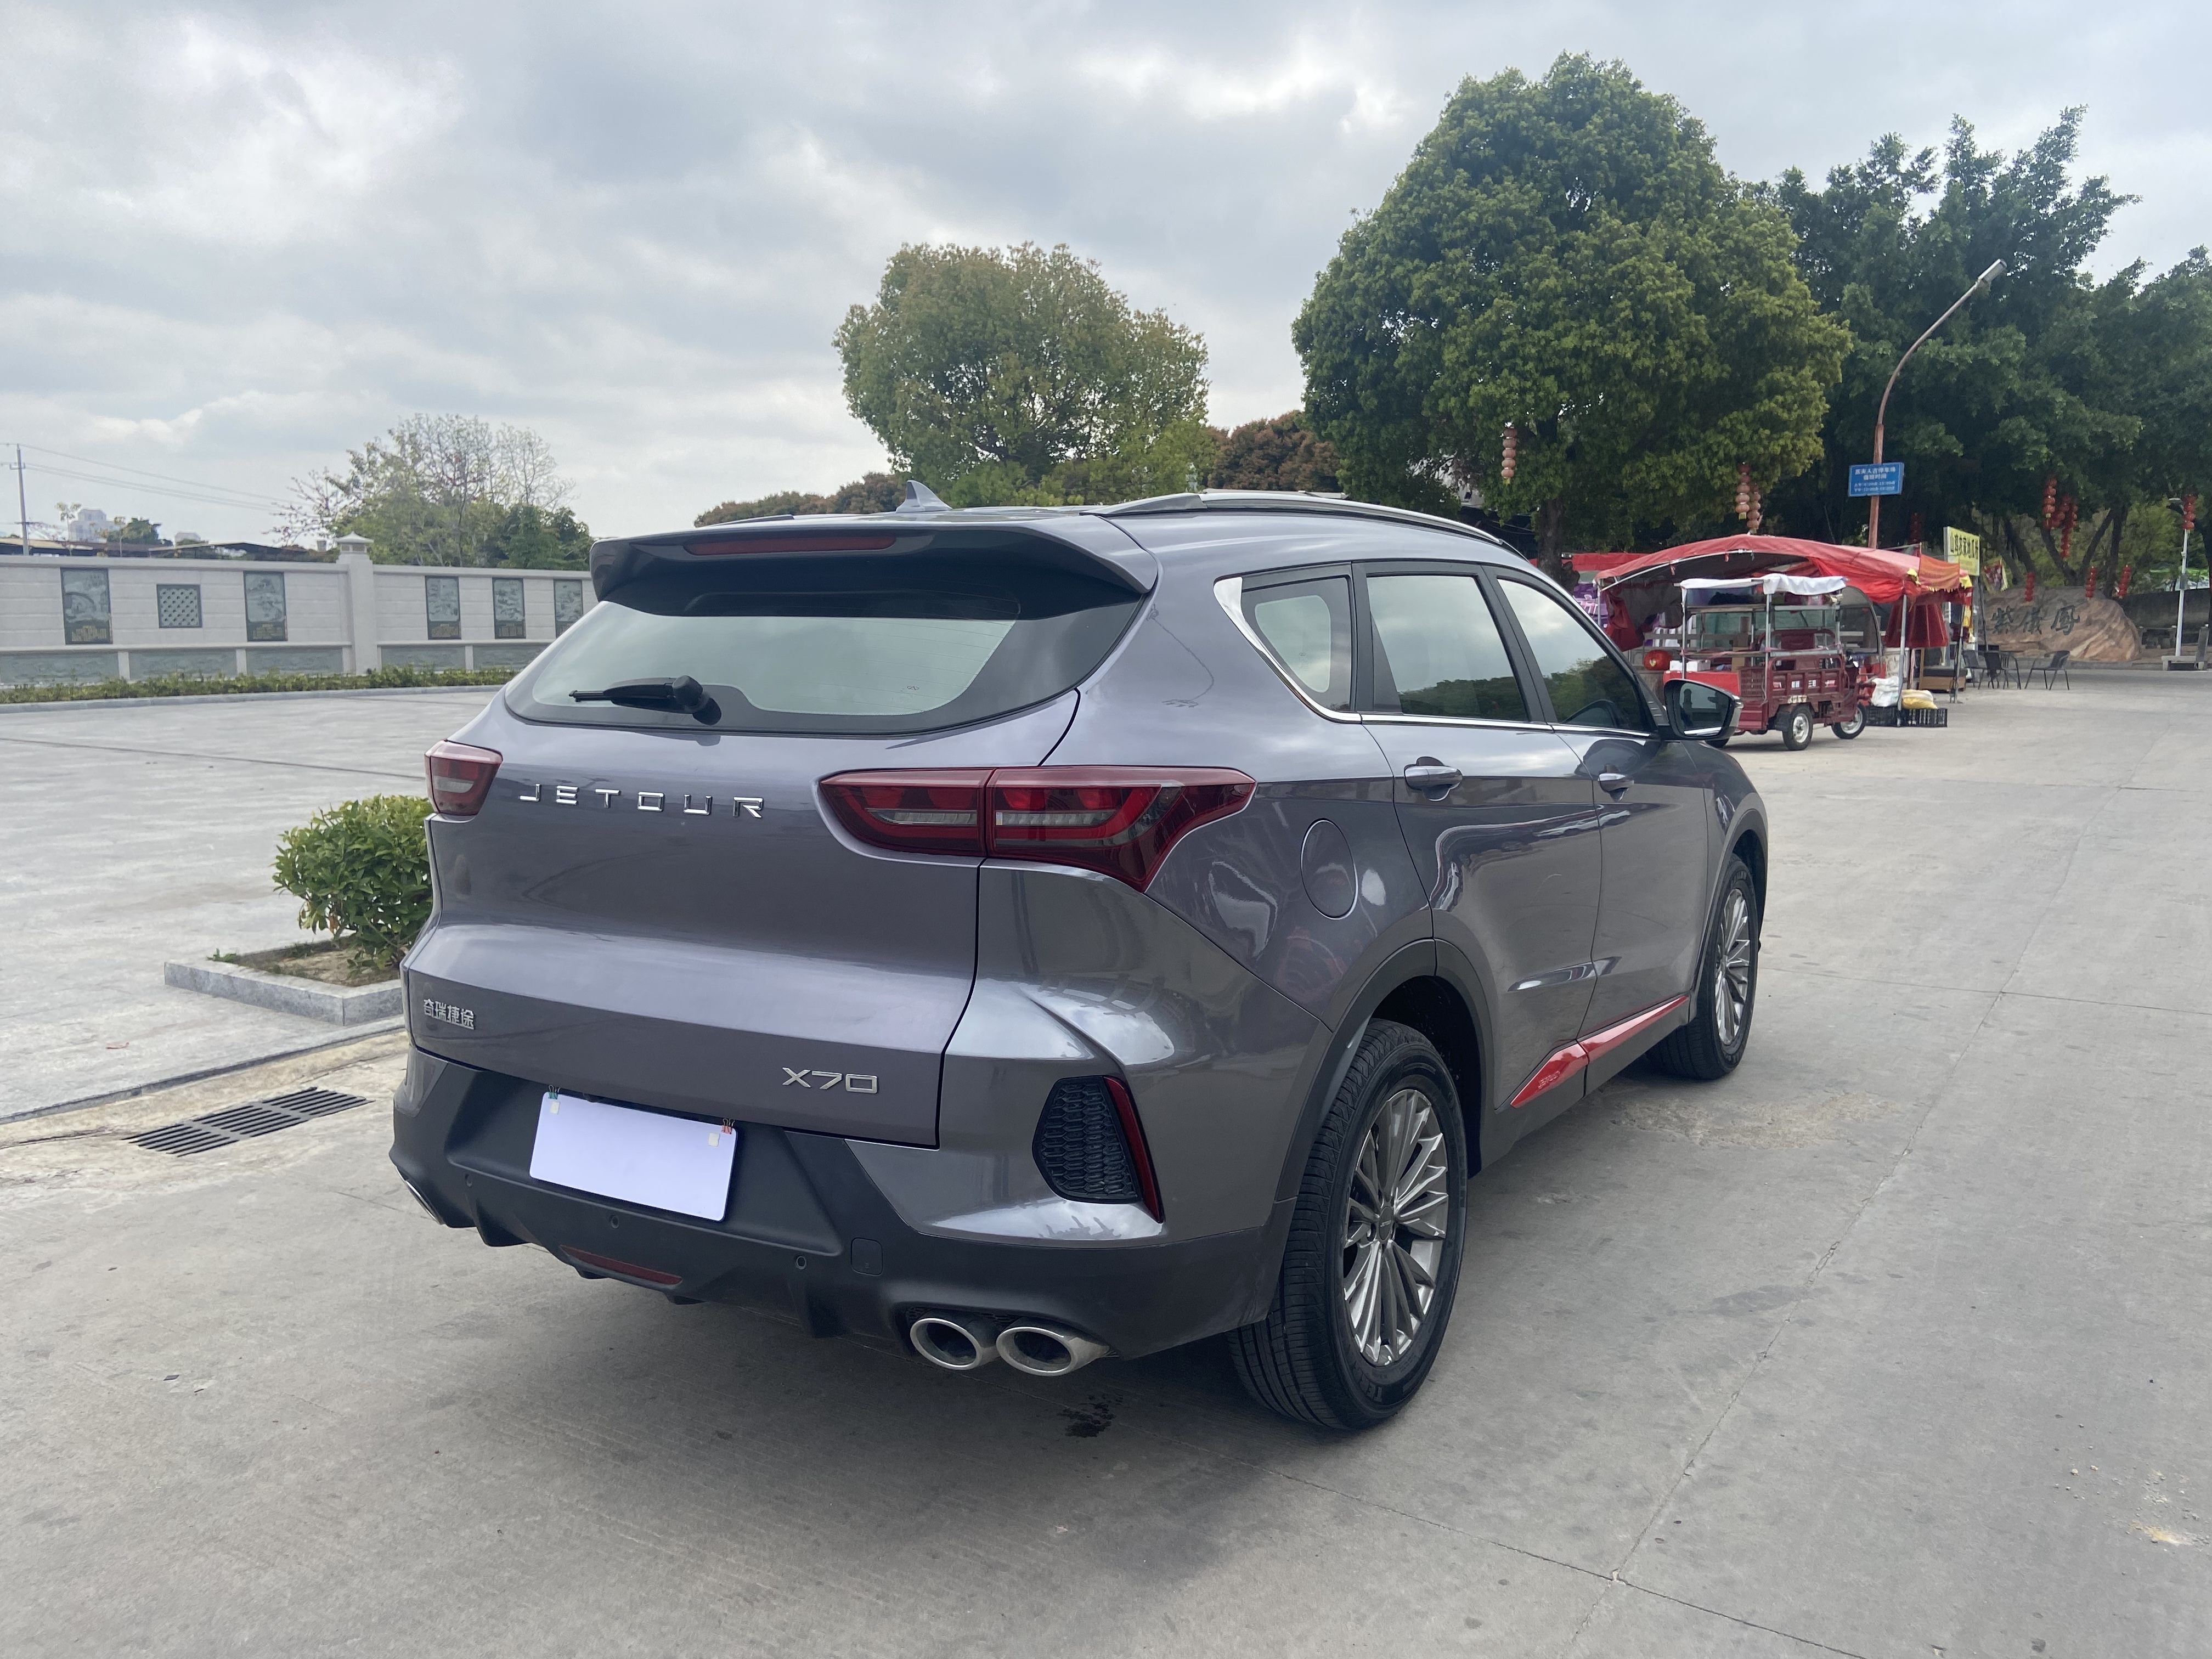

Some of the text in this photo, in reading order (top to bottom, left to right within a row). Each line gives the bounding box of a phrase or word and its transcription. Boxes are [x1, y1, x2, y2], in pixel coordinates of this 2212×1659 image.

[518, 783, 764, 818] JETOUR
[424, 998, 475, 1030] 奇瑞捷途
[782, 1067, 879, 1094] X70
